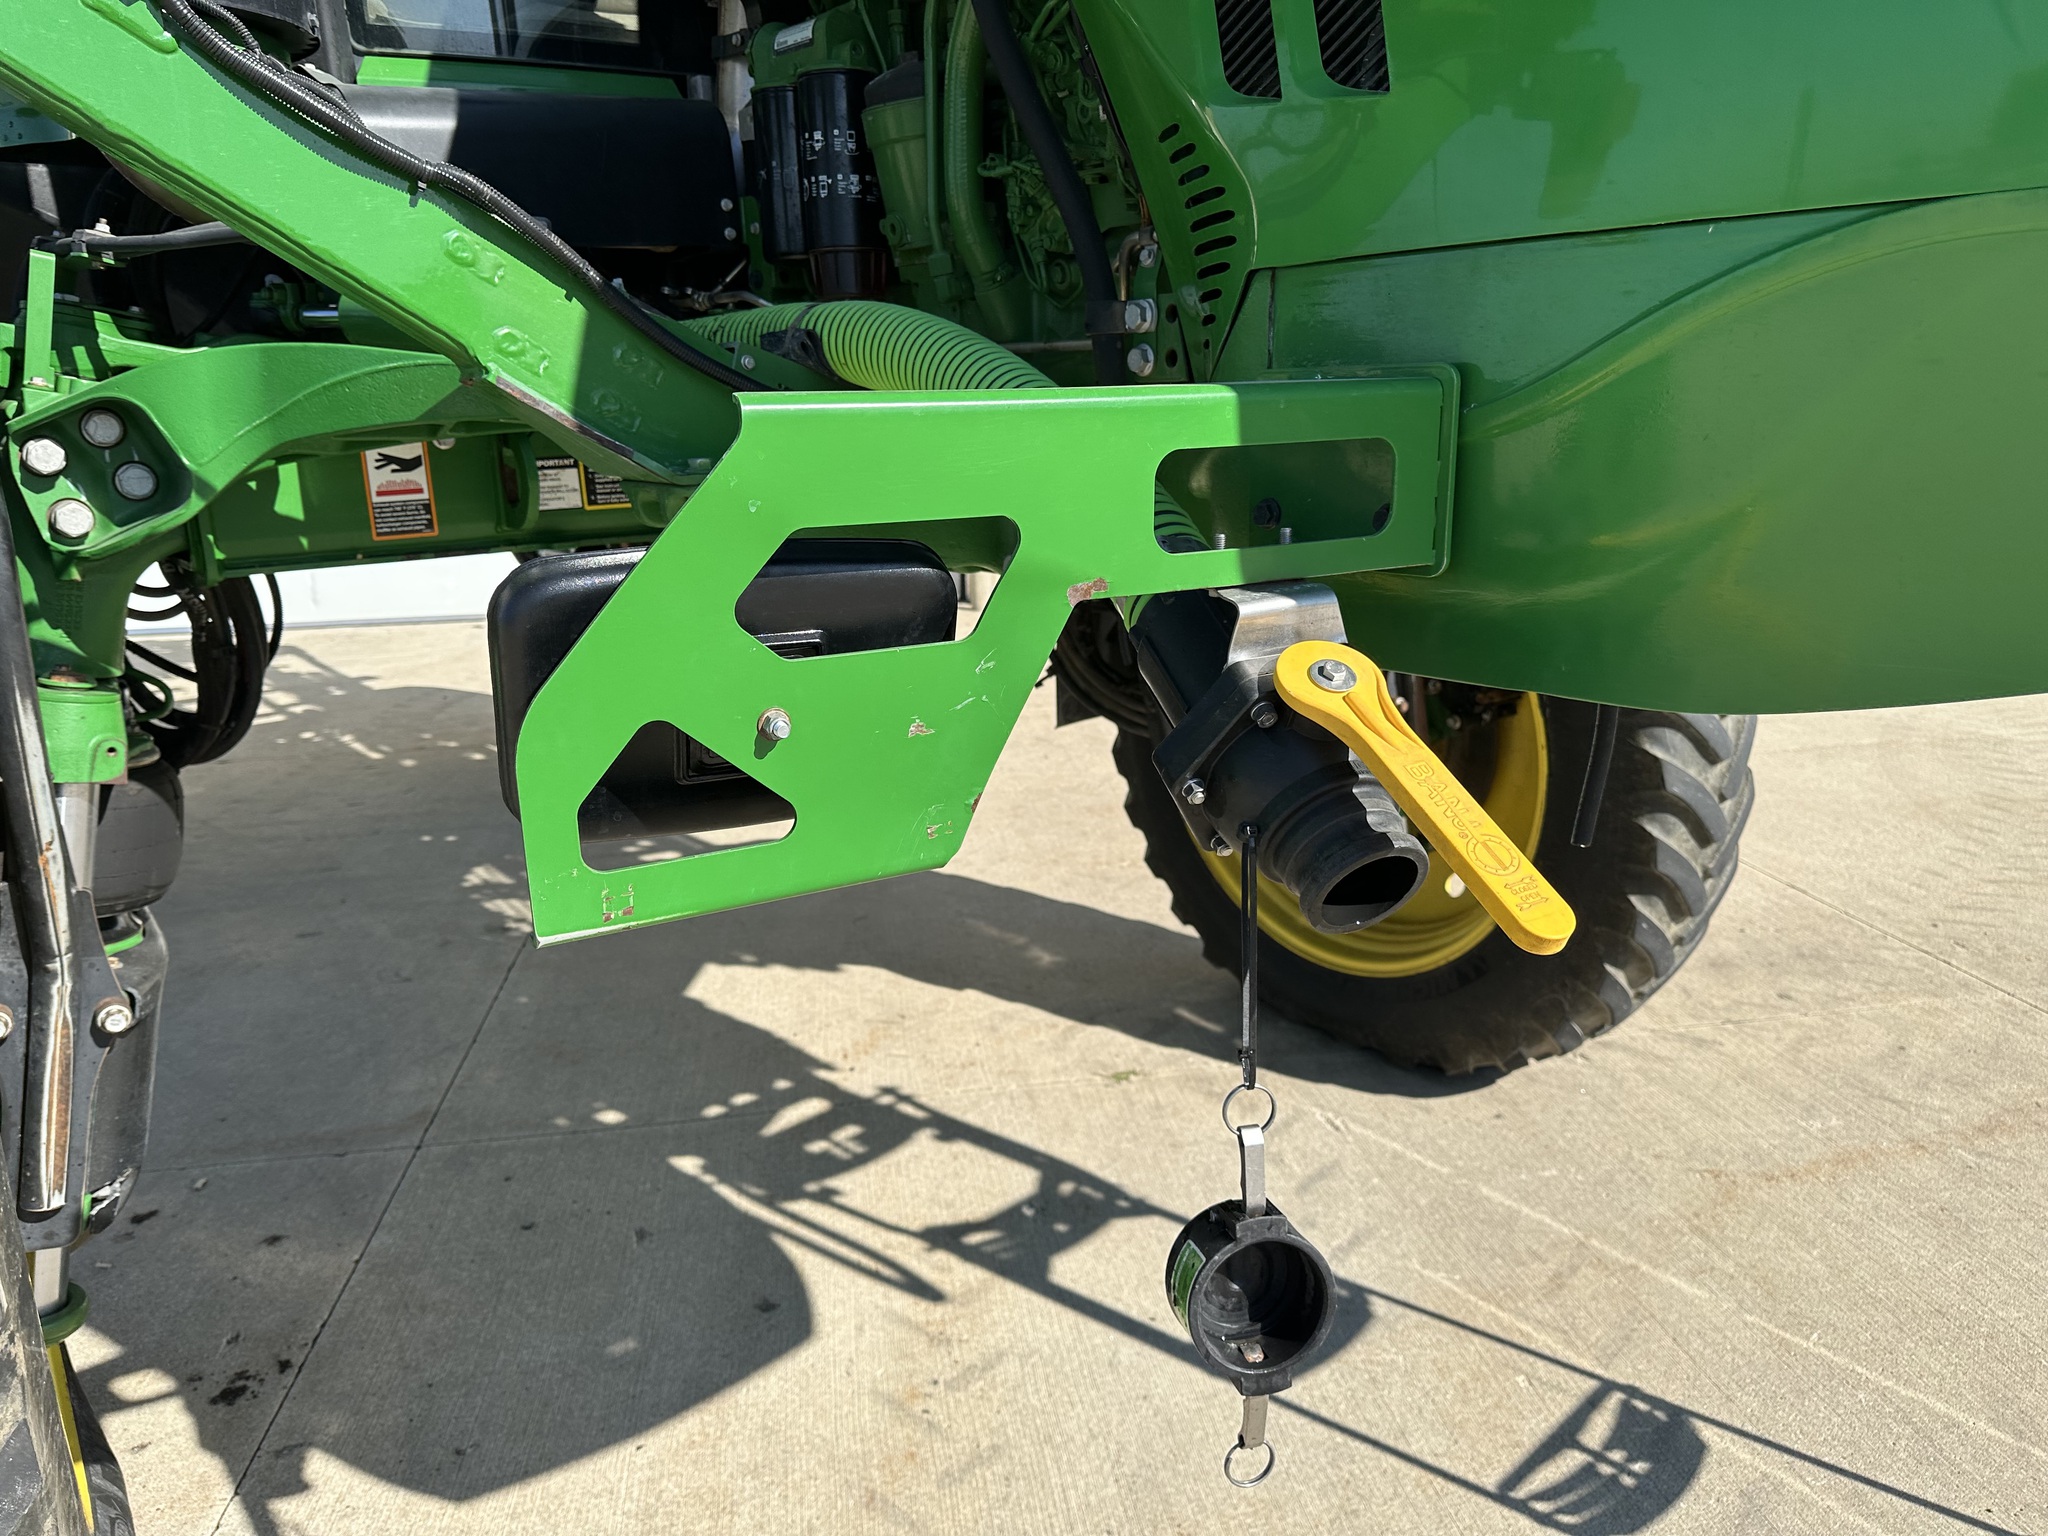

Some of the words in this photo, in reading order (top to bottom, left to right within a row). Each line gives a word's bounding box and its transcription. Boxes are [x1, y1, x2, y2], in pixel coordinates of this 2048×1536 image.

[536, 459, 575, 468] PORTANT
[1510, 882, 1538, 896] CLOSED
[1520, 890, 1541, 902] OPEN
